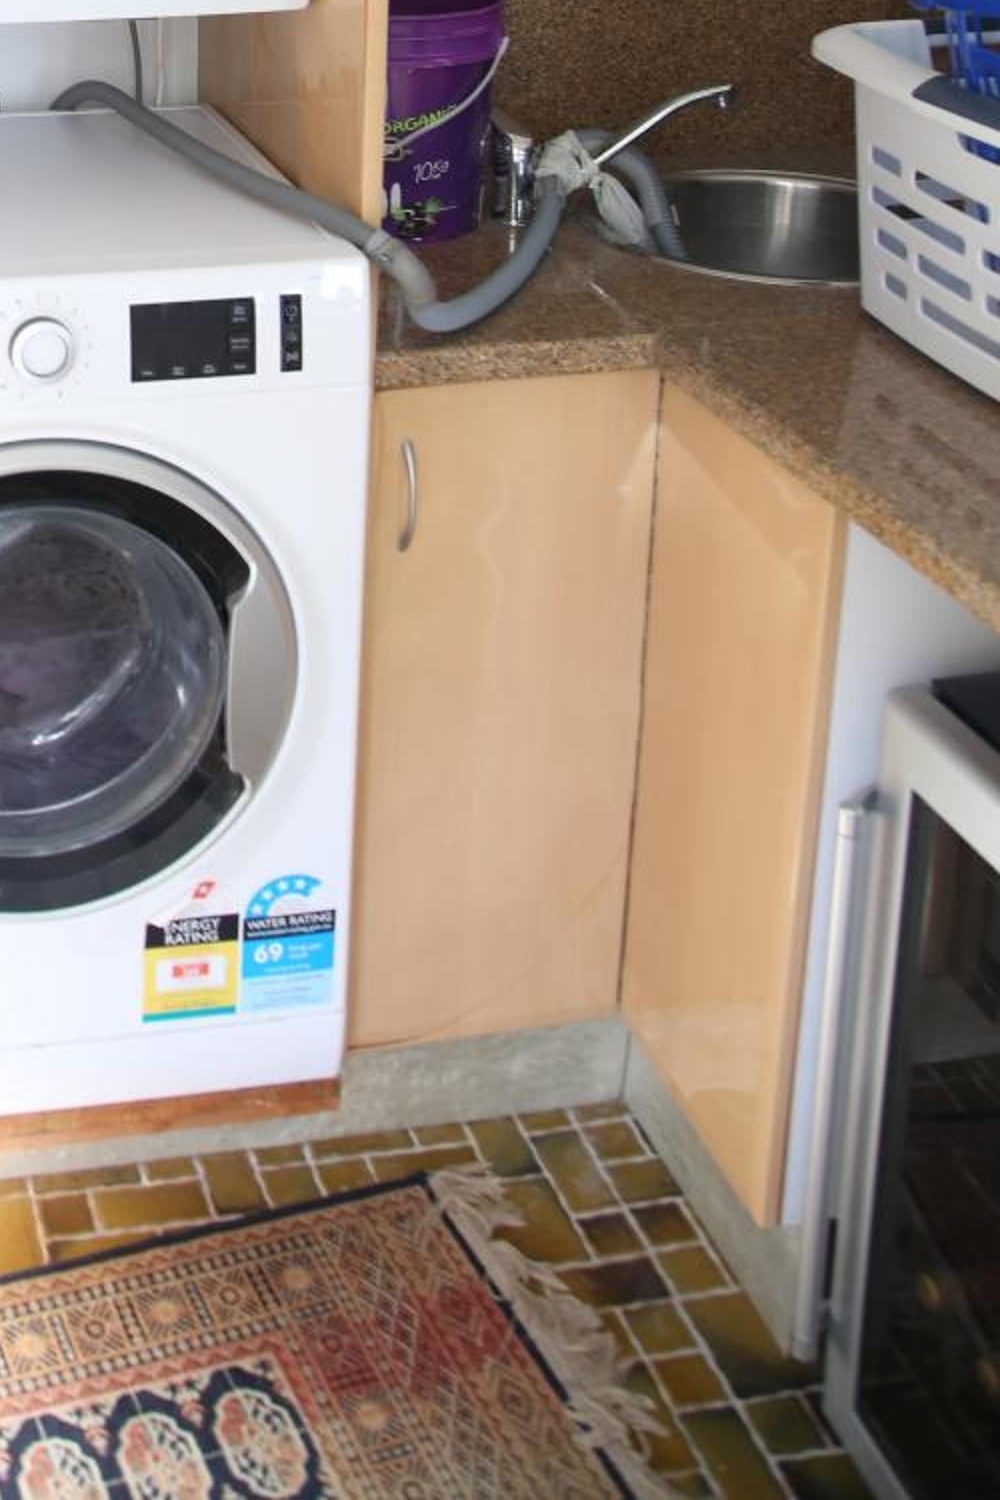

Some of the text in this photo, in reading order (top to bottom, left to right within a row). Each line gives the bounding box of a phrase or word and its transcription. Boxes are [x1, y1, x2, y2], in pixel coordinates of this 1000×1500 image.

[247, 915, 287, 931] WATER
[289, 909, 333, 926] RATING
[165, 929, 220, 945] RATING
[254, 942, 283, 965] 69
